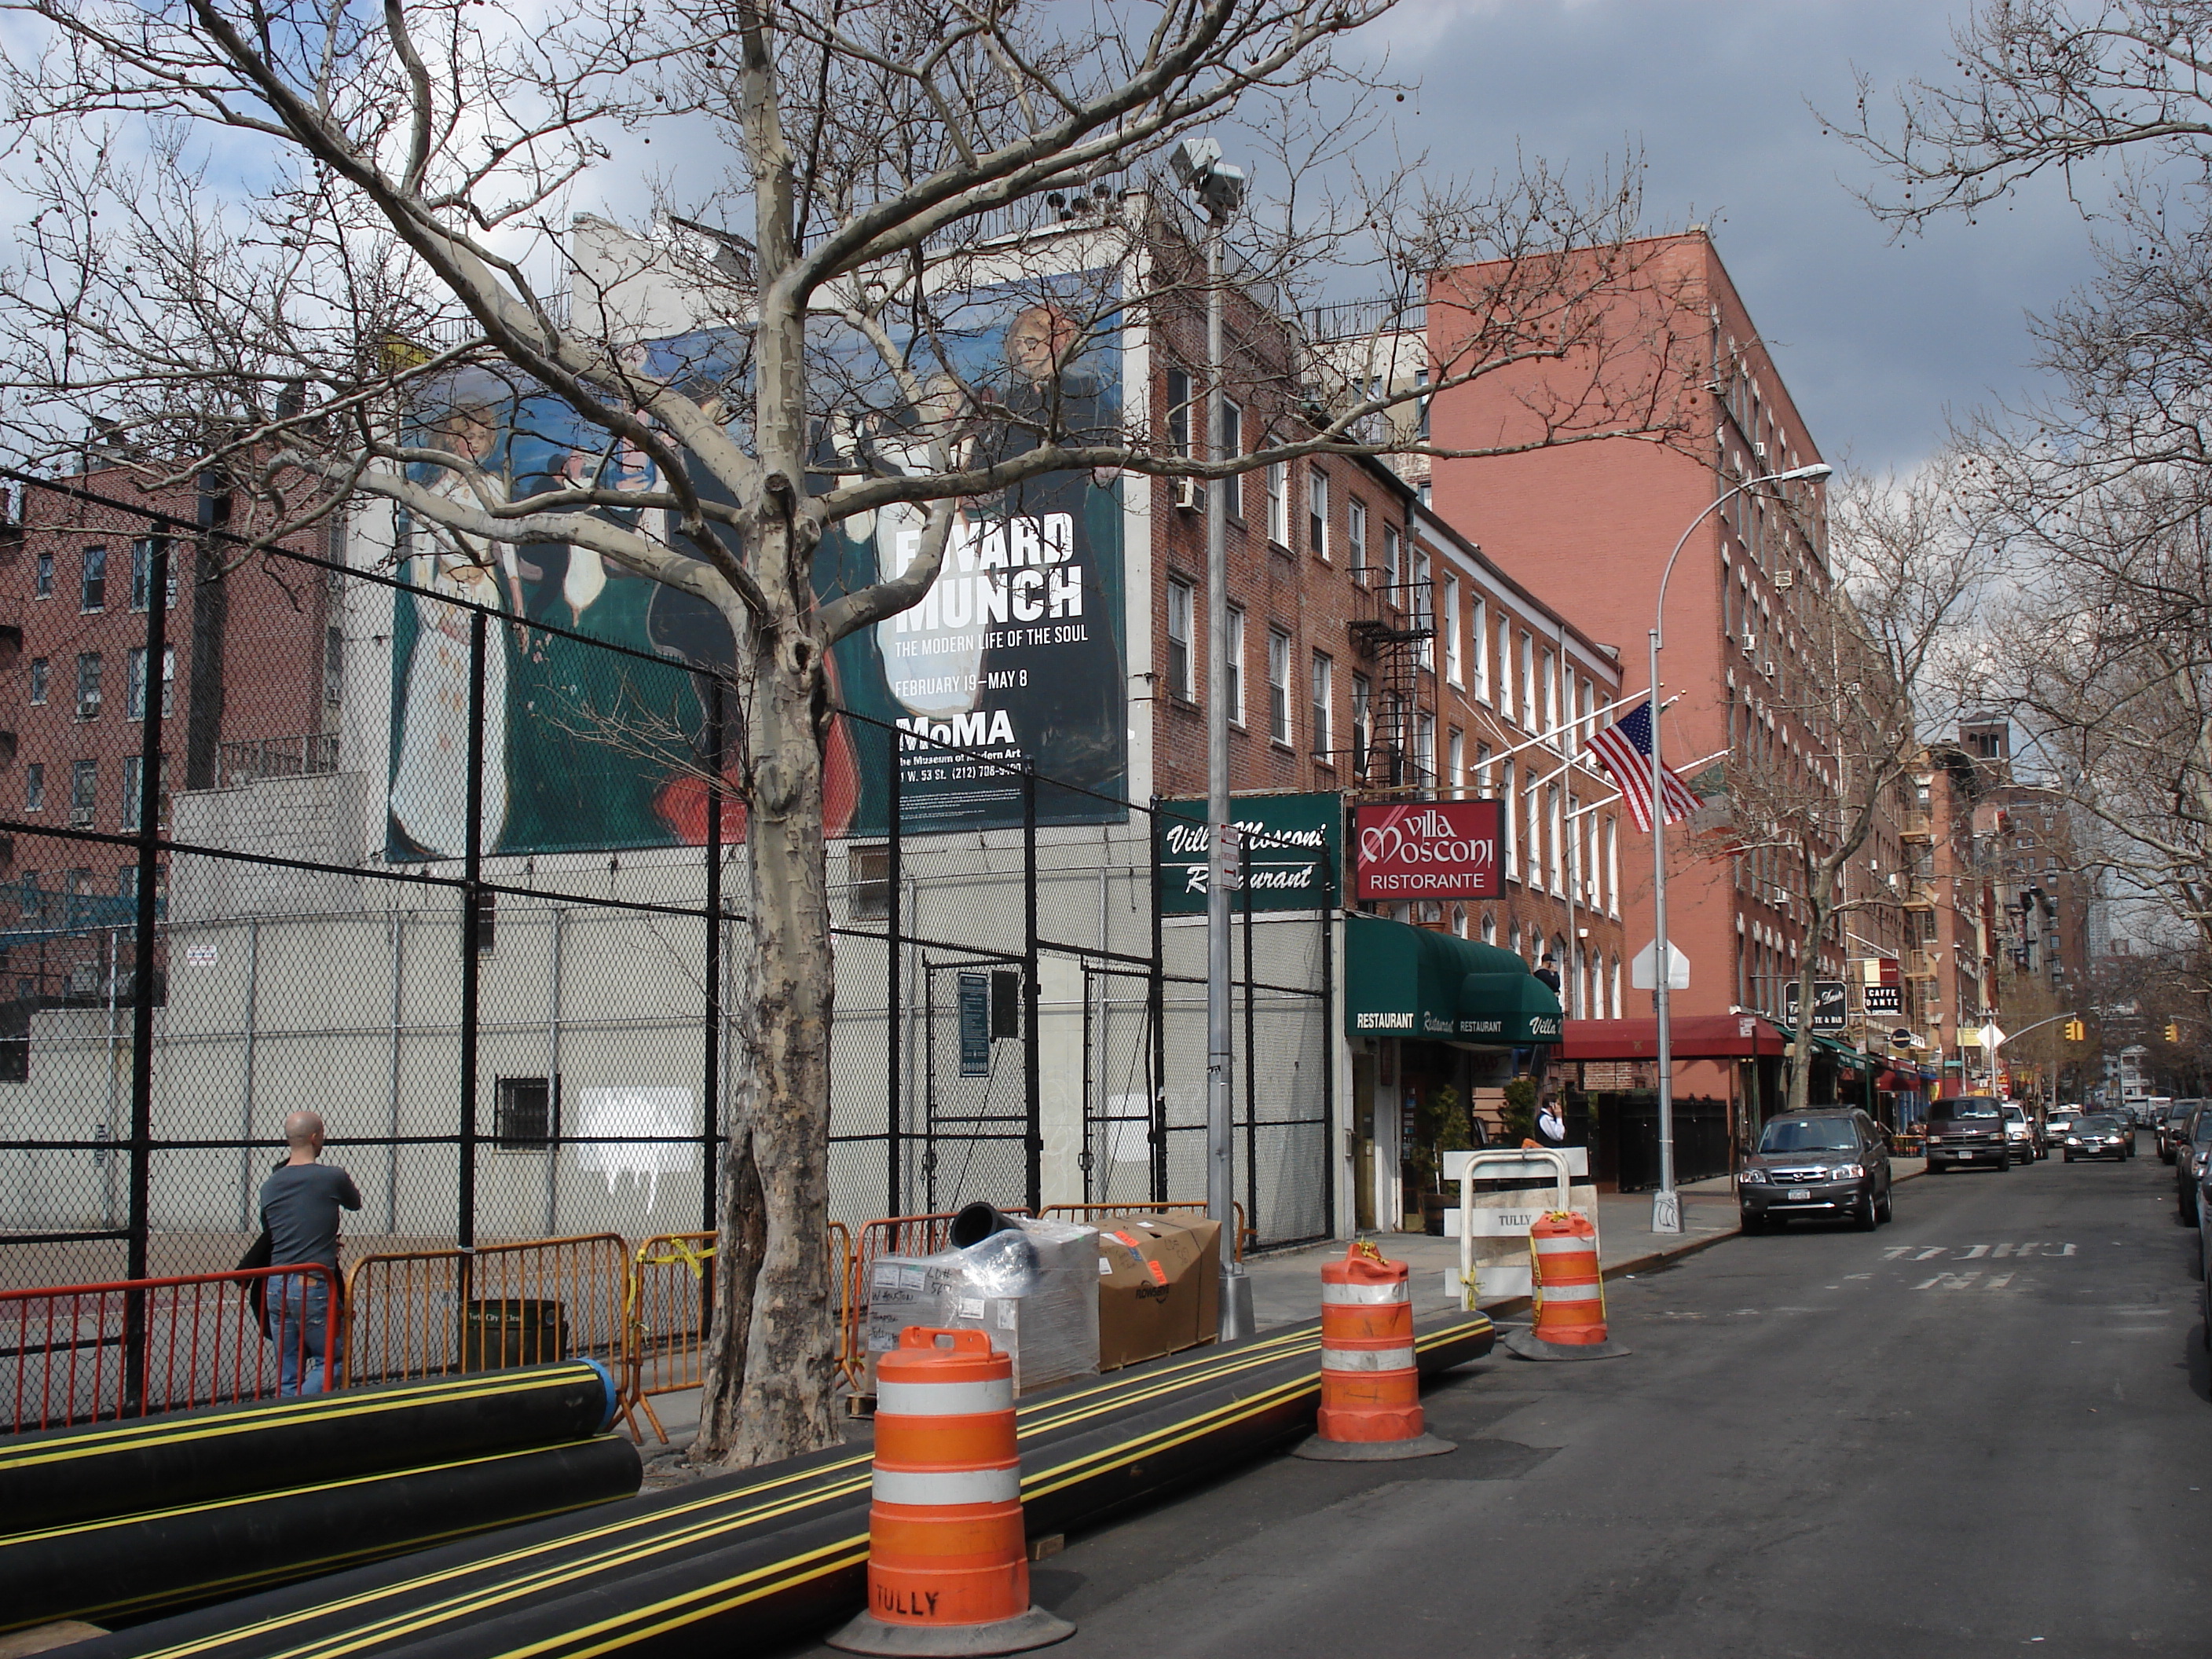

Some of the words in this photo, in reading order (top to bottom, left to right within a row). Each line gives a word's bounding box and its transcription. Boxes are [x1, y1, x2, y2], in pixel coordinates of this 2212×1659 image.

[896, 565, 1082, 633] MUNCH
[895, 640, 918, 658] THE
[921, 635, 974, 655] MODERN
[978, 631, 1004, 650] LIFE
[1007, 630, 1024, 648] OF
[1027, 627, 1051, 646] THE
[1054, 624, 1089, 643] SOUL
[895, 676, 960, 698] FEBRUARY
[1019, 668, 1028, 687] 8
[895, 709, 1016, 752] MoMA
[913, 755, 954, 765] Museum
[954, 753, 965, 762] of
[1005, 748, 1022, 758] Art
[921, 769, 932, 782] 53
[951, 767, 976, 780] (212)
[1166, 824, 1210, 855] Vill
[1370, 873, 1485, 890] RISTORANTE
[1866, 998, 1899, 1007] DANTE
[1868, 989, 1896, 998] CAFFE
[1357, 1012, 1414, 1030] RESTAURANT
[1459, 1020, 1503, 1033] RESTAURANT
[1529, 1016, 1556, 1035] Villa
[1499, 1214, 1532, 1226] TULLY
[877, 1584, 939, 1617] TULLY
